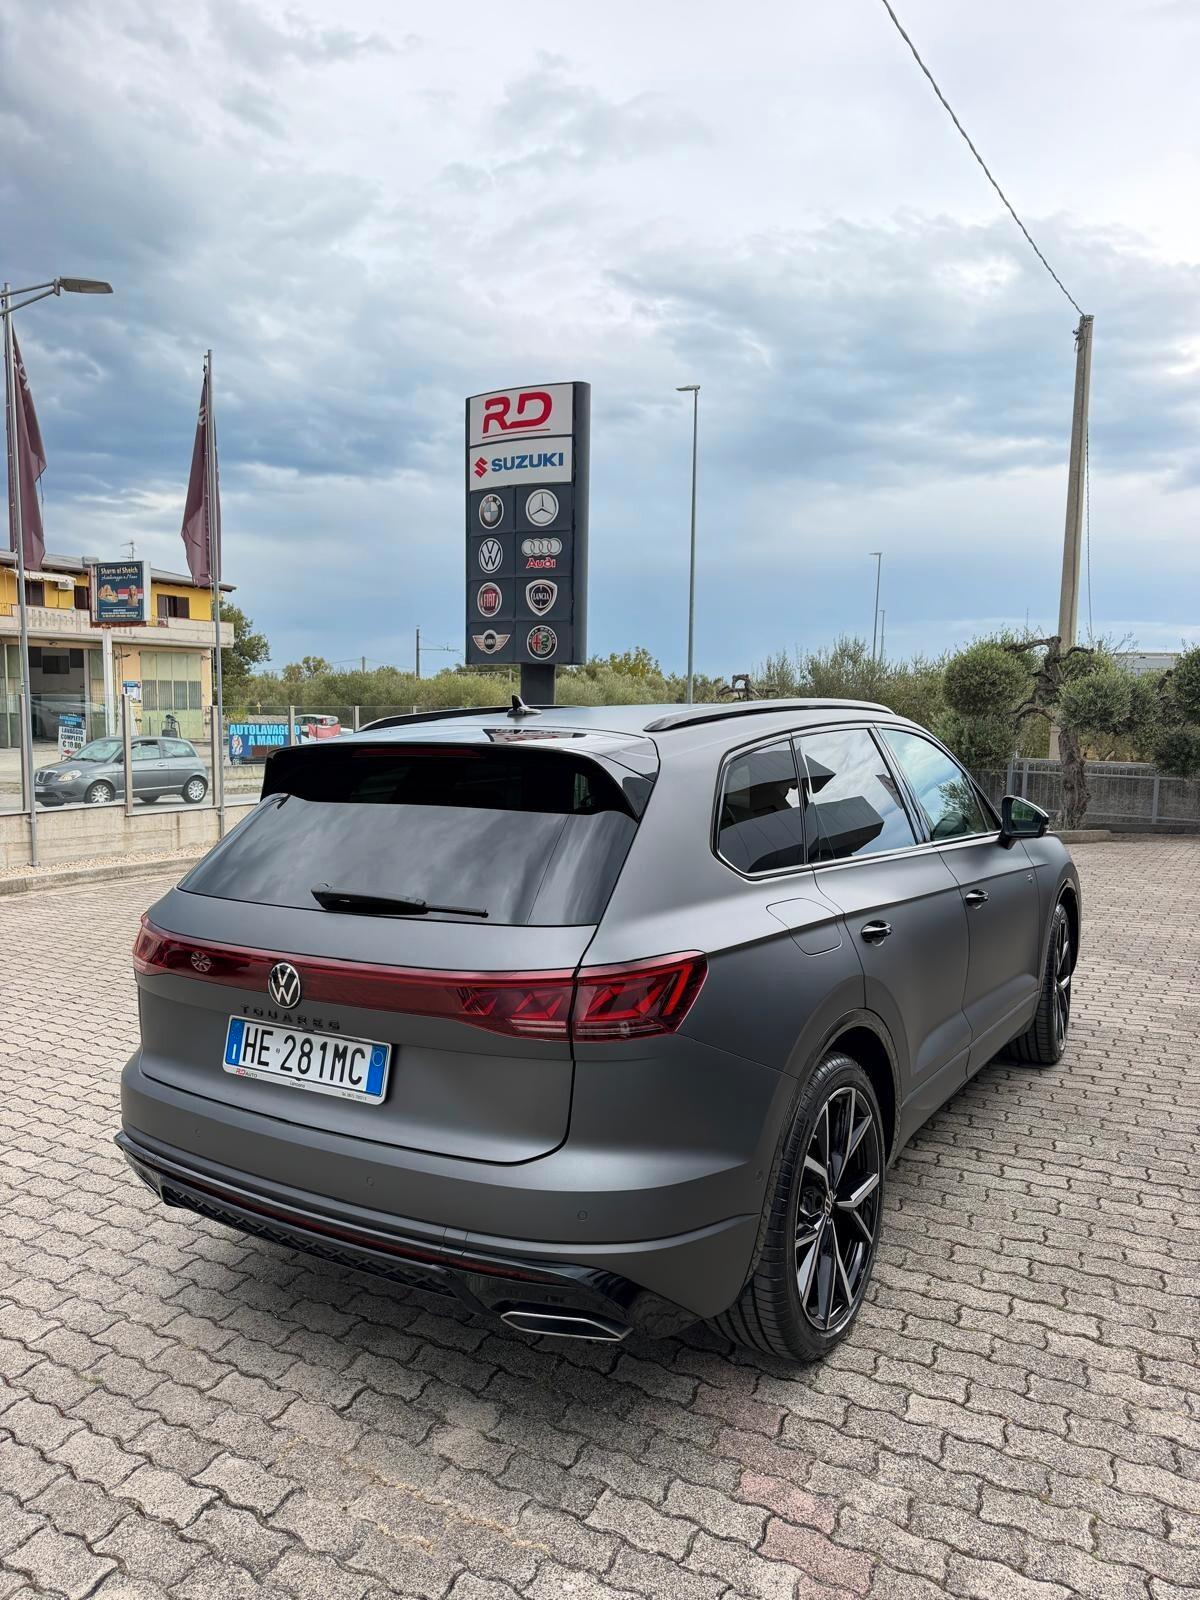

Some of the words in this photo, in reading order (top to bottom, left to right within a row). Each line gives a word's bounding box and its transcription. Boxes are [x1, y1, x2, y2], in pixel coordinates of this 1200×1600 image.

[491, 452, 563, 472] SUZUKI
[526, 557, 557, 569] Audi
[483, 593, 496, 607] FIAT
[532, 592, 550, 601] LANCIA
[229, 724, 300, 735] AUTOLAVAGGO
[248, 735, 255, 746] A
[256, 735, 285, 746] MANO
[241, 1004, 341, 1030] TOUAREG
[242, 1026, 274, 1067] HE
[280, 1034, 366, 1086] 281MC
